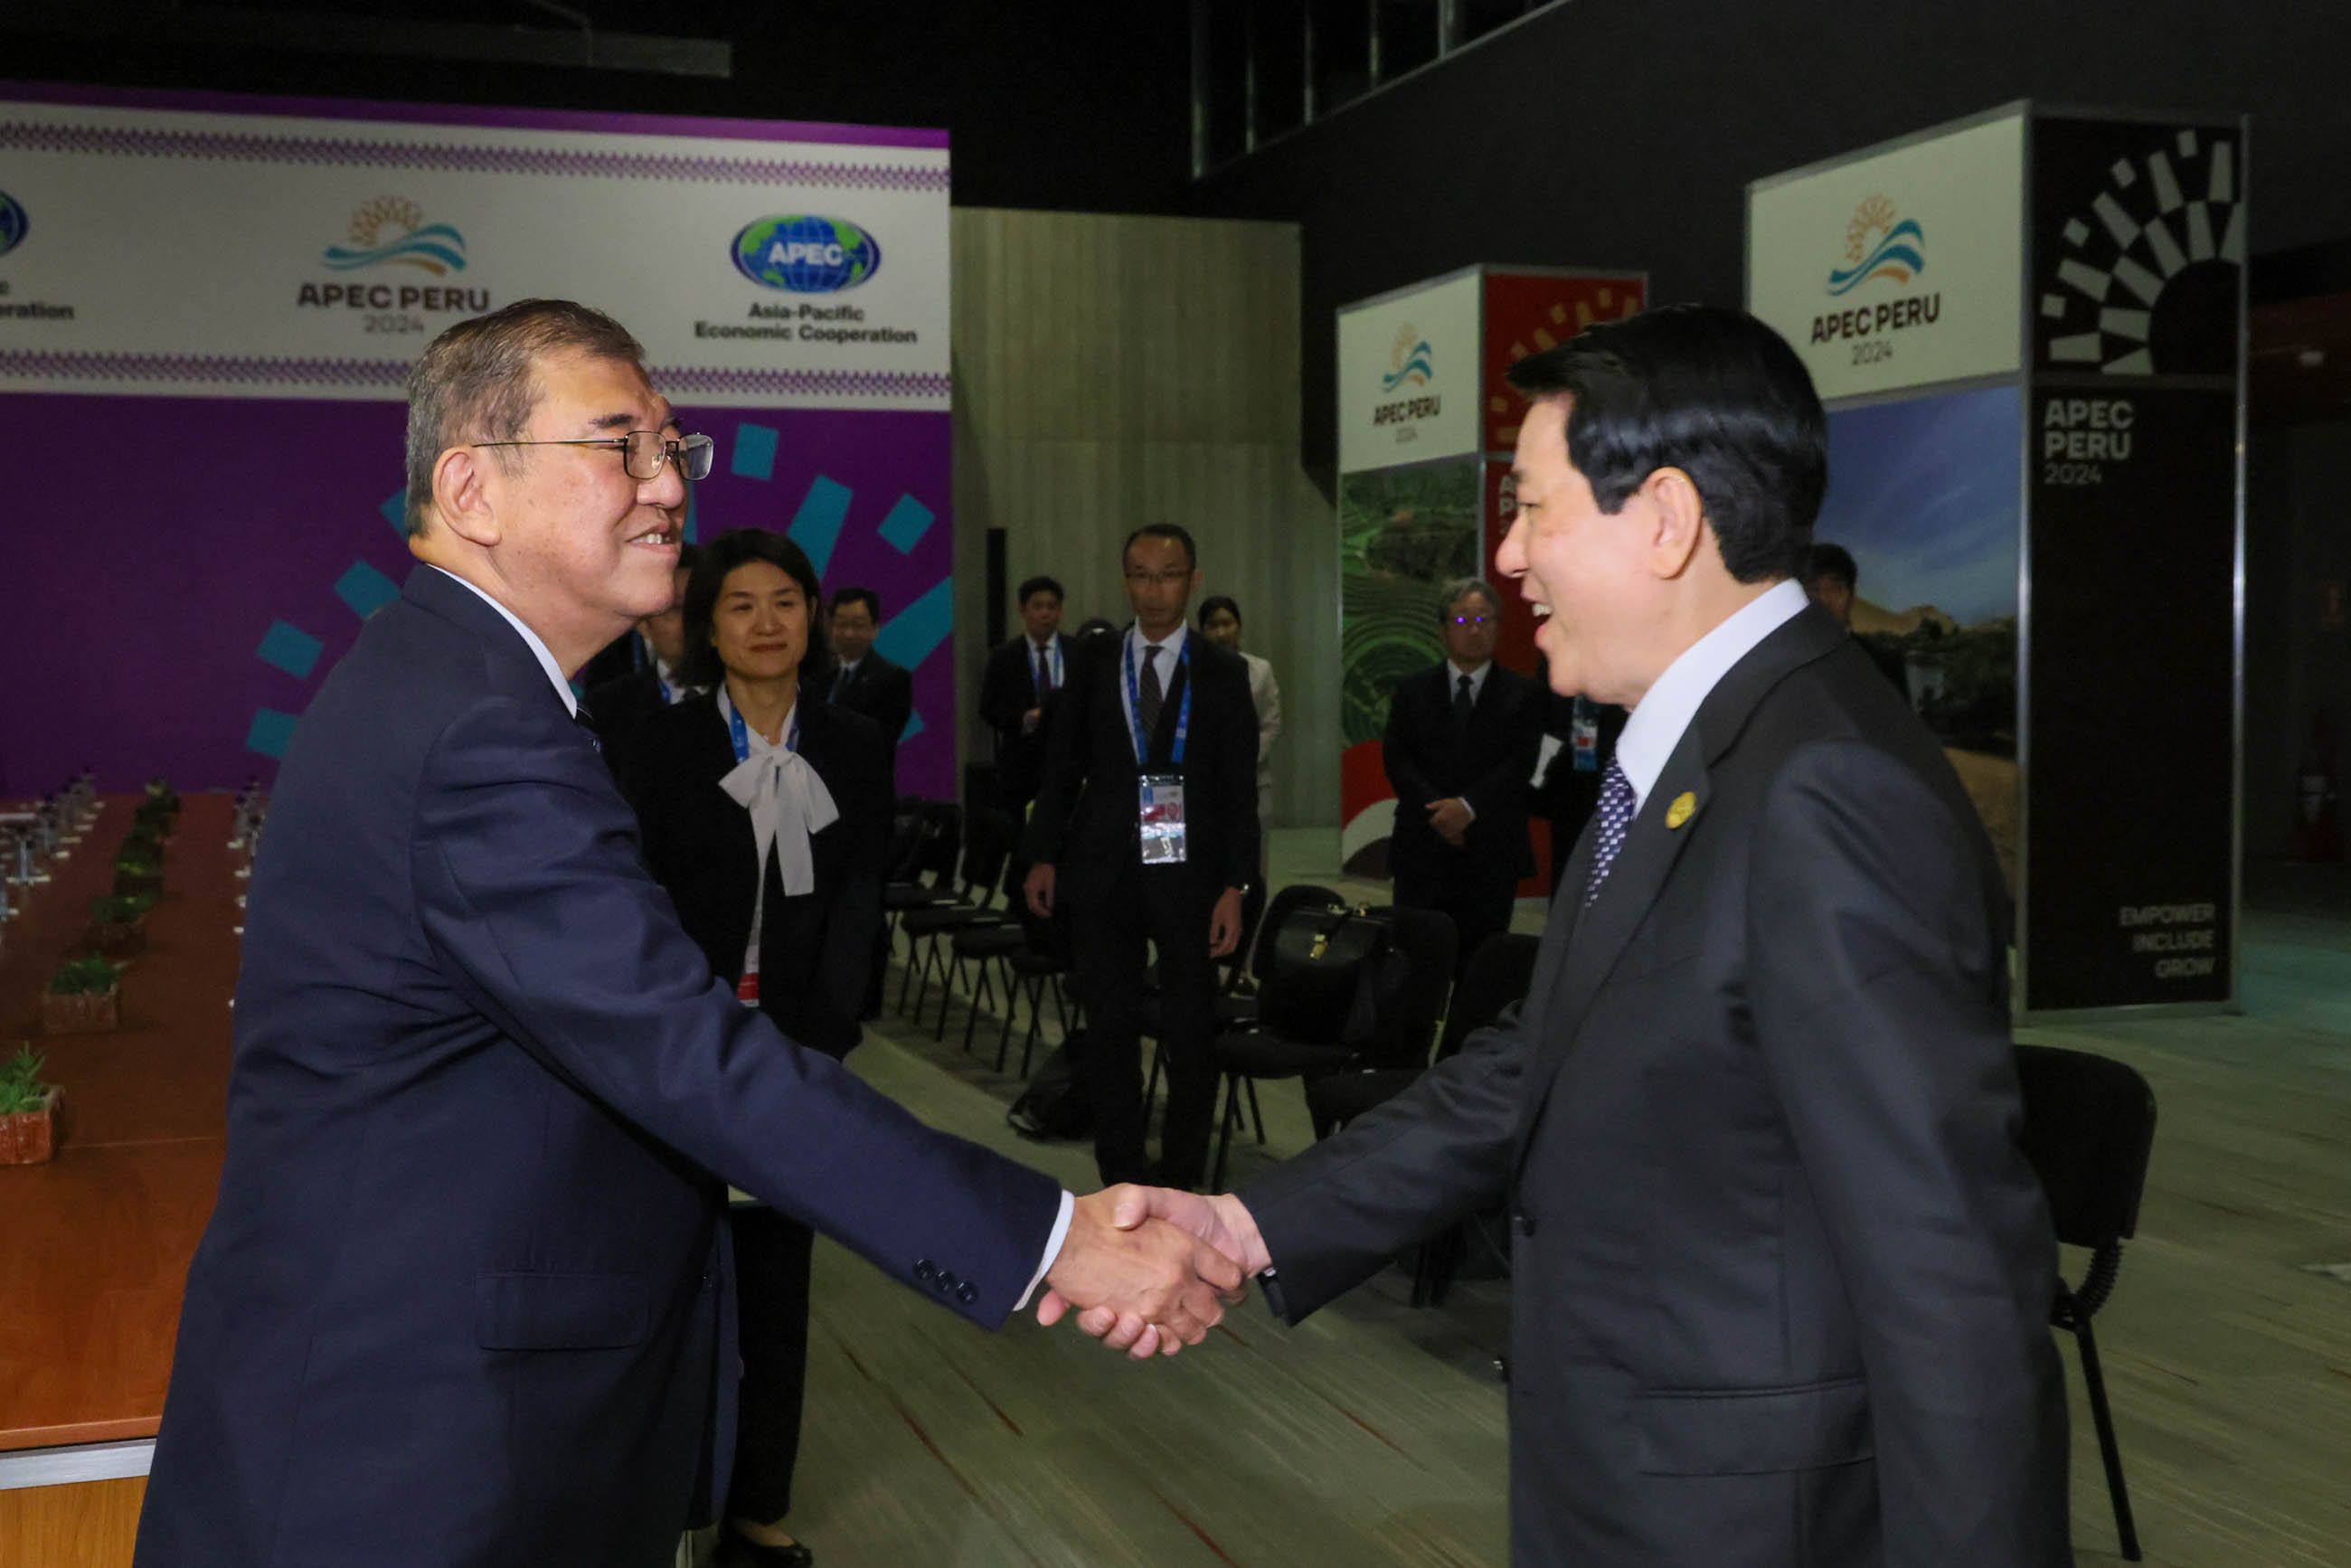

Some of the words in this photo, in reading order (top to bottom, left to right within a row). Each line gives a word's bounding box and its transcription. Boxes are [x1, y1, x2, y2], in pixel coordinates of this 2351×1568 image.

[769, 241, 843, 265] APEC
[0, 299, 74, 319] eration
[297, 283, 392, 308] APEC
[400, 286, 489, 312] PERU
[748, 302, 864, 322] Asia-Pacific
[1811, 307, 1871, 343] APEC
[1875, 292, 1940, 332] PERU
[365, 315, 424, 334] 2024
[694, 321, 792, 340] Economic
[798, 324, 917, 345] Cooperation
[1852, 340, 1893, 365] 2024
[1374, 401, 1406, 427] APEC
[1408, 395, 1440, 421] PERU
[2045, 399, 2134, 429] APEC
[2045, 430, 2132, 460] PERU
[2044, 462, 2102, 485] 2024
[2120, 903, 2214, 926] EMPOWER
[2132, 930, 2214, 952] INCLUDE
[2155, 958, 2214, 978] GROW
